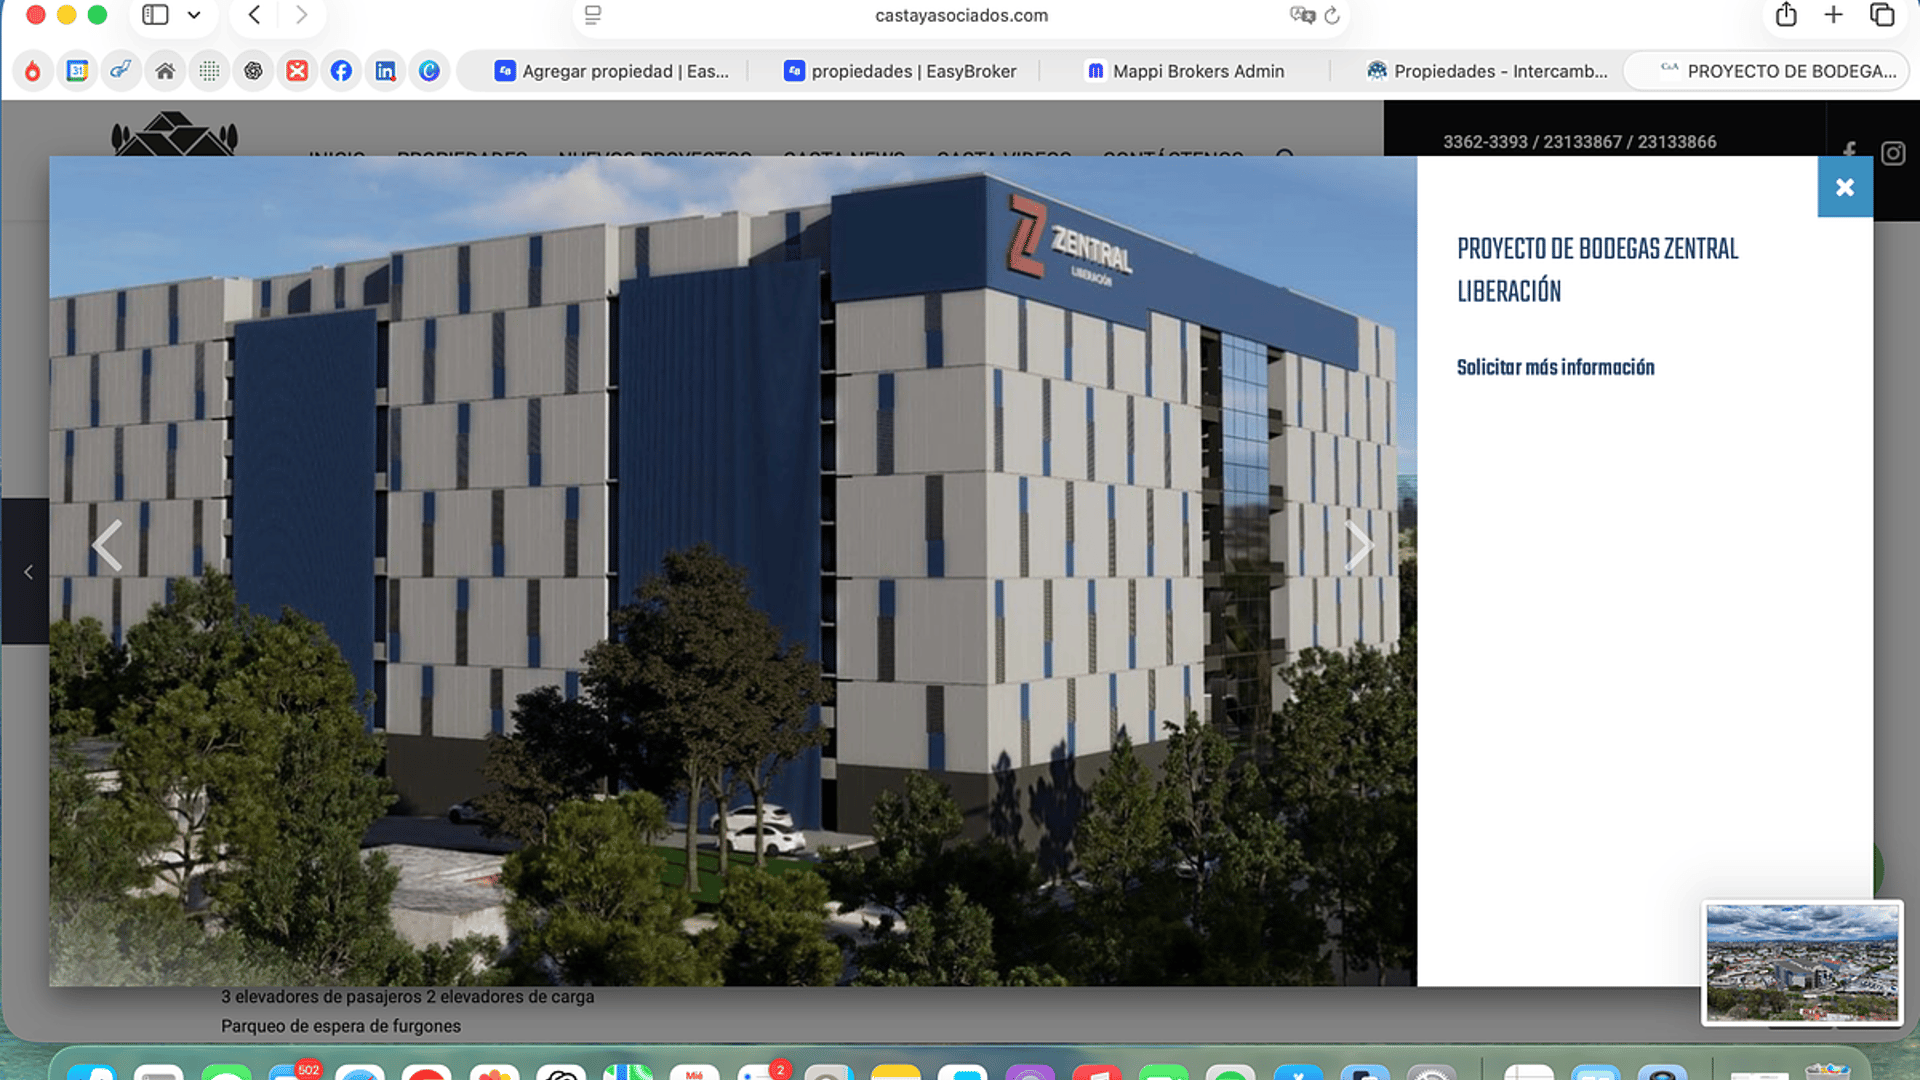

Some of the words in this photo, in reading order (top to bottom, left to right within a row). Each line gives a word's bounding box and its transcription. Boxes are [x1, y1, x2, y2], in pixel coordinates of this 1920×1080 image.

[875, 8, 1049, 26] castayasociados.com
[523, 64, 587, 82] Agregar
[592, 63, 672, 82] propiedad
[812, 63, 912, 82] propiedades
[926, 64, 1018, 82] EasyBroker
[1114, 64, 1163, 82] Mappi
[1168, 64, 1230, 79] Brokers
[1233, 64, 1285, 79] Admin
[1394, 63, 1496, 82] Propiedades
[1688, 64, 1780, 79] PROYECTO
[1785, 64, 1807, 79] DE
[1443, 134, 1529, 149] 3362-3393
[1543, 134, 1623, 149] 23133867
[1638, 134, 1718, 149] 23133866
[1051, 225, 1134, 275] ZENTRAL
[1458, 236, 1547, 260] PROYECTO
[1551, 236, 1575, 260] DE
[1579, 236, 1660, 260] BODEGAS
[1663, 236, 1740, 260] ZENTRAL
[1458, 274, 1562, 303] LIBERACIÓN
[1457, 357, 1523, 376] Solicitar
[1525, 358, 1558, 376] más
[1561, 357, 1656, 376] información
[221, 989, 231, 1004] 3
[235, 989, 319, 1004] elevadores
[323, 989, 343, 1004] de
[346, 989, 422, 1007] pasajeros
[426, 989, 436, 1004] 2
[440, 989, 524, 1004] elevadores
[528, 989, 548, 1004] de
[551, 992, 595, 1007] carga
[221, 1018, 286, 1037] Parqueo
[289, 1018, 310, 1034] de
[313, 1021, 366, 1037] espera
[369, 1018, 389, 1034] de
[392, 1018, 462, 1037] furgones
[298, 1064, 319, 1075] 502
[777, 1065, 785, 1075] 2
